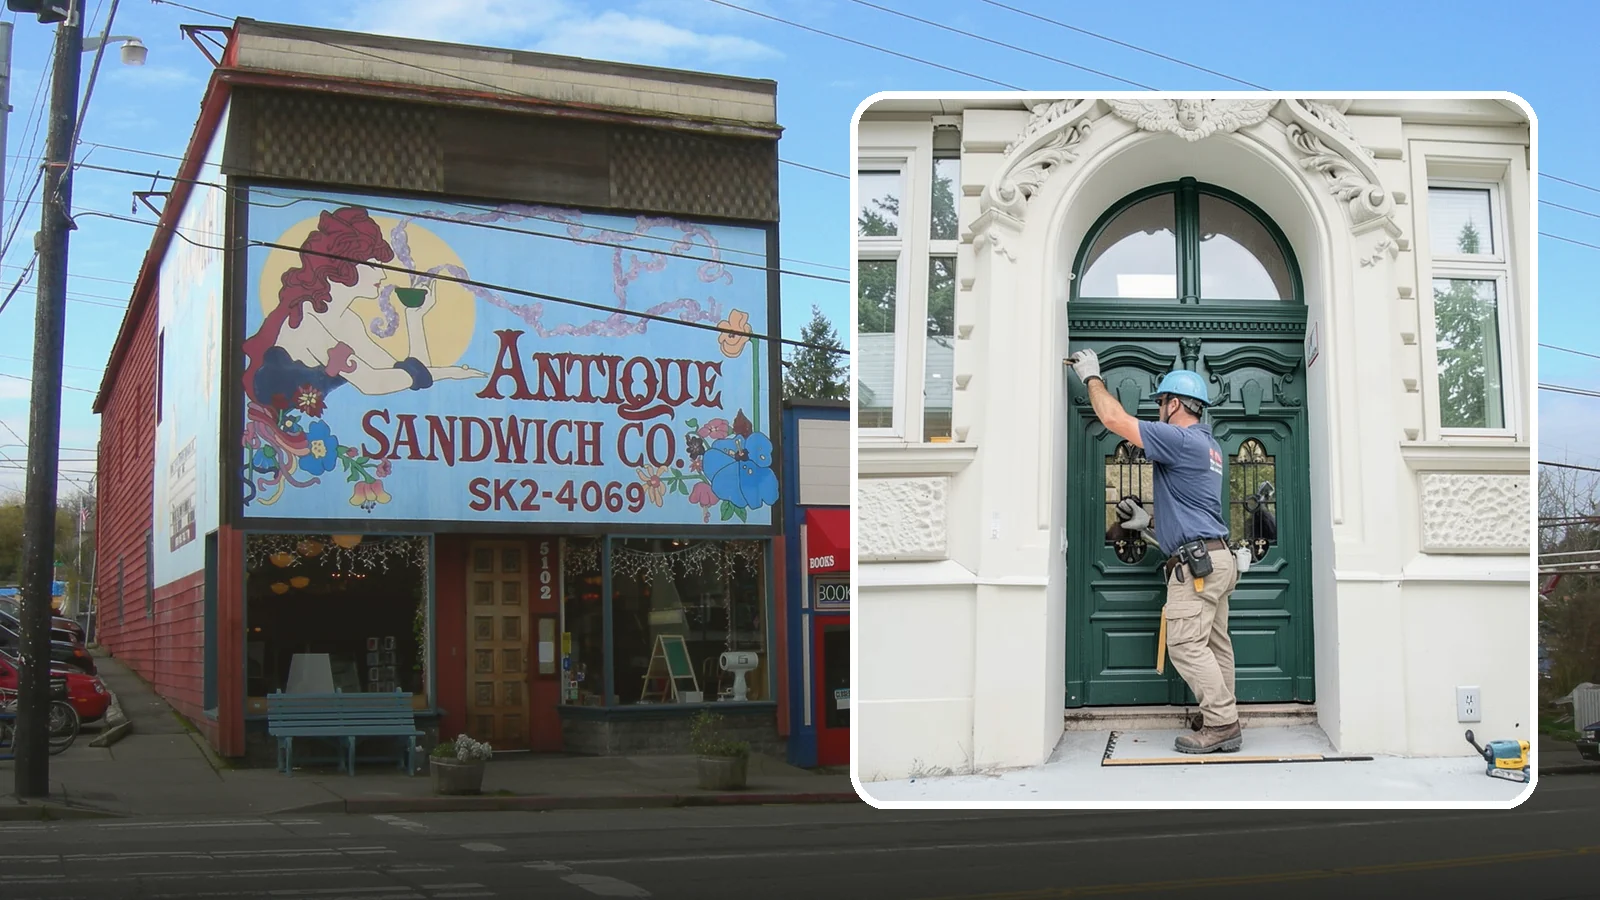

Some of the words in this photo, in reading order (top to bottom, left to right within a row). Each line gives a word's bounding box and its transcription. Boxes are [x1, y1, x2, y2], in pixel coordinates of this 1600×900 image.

[475, 328, 724, 421] ANTIQUE
[361, 408, 605, 468] SANDWICH
[617, 421, 686, 469] CO.
[468, 477, 645, 513] SK2-4069
[540, 541, 552, 600] 5102
[809, 555, 835, 569] BOOKS
